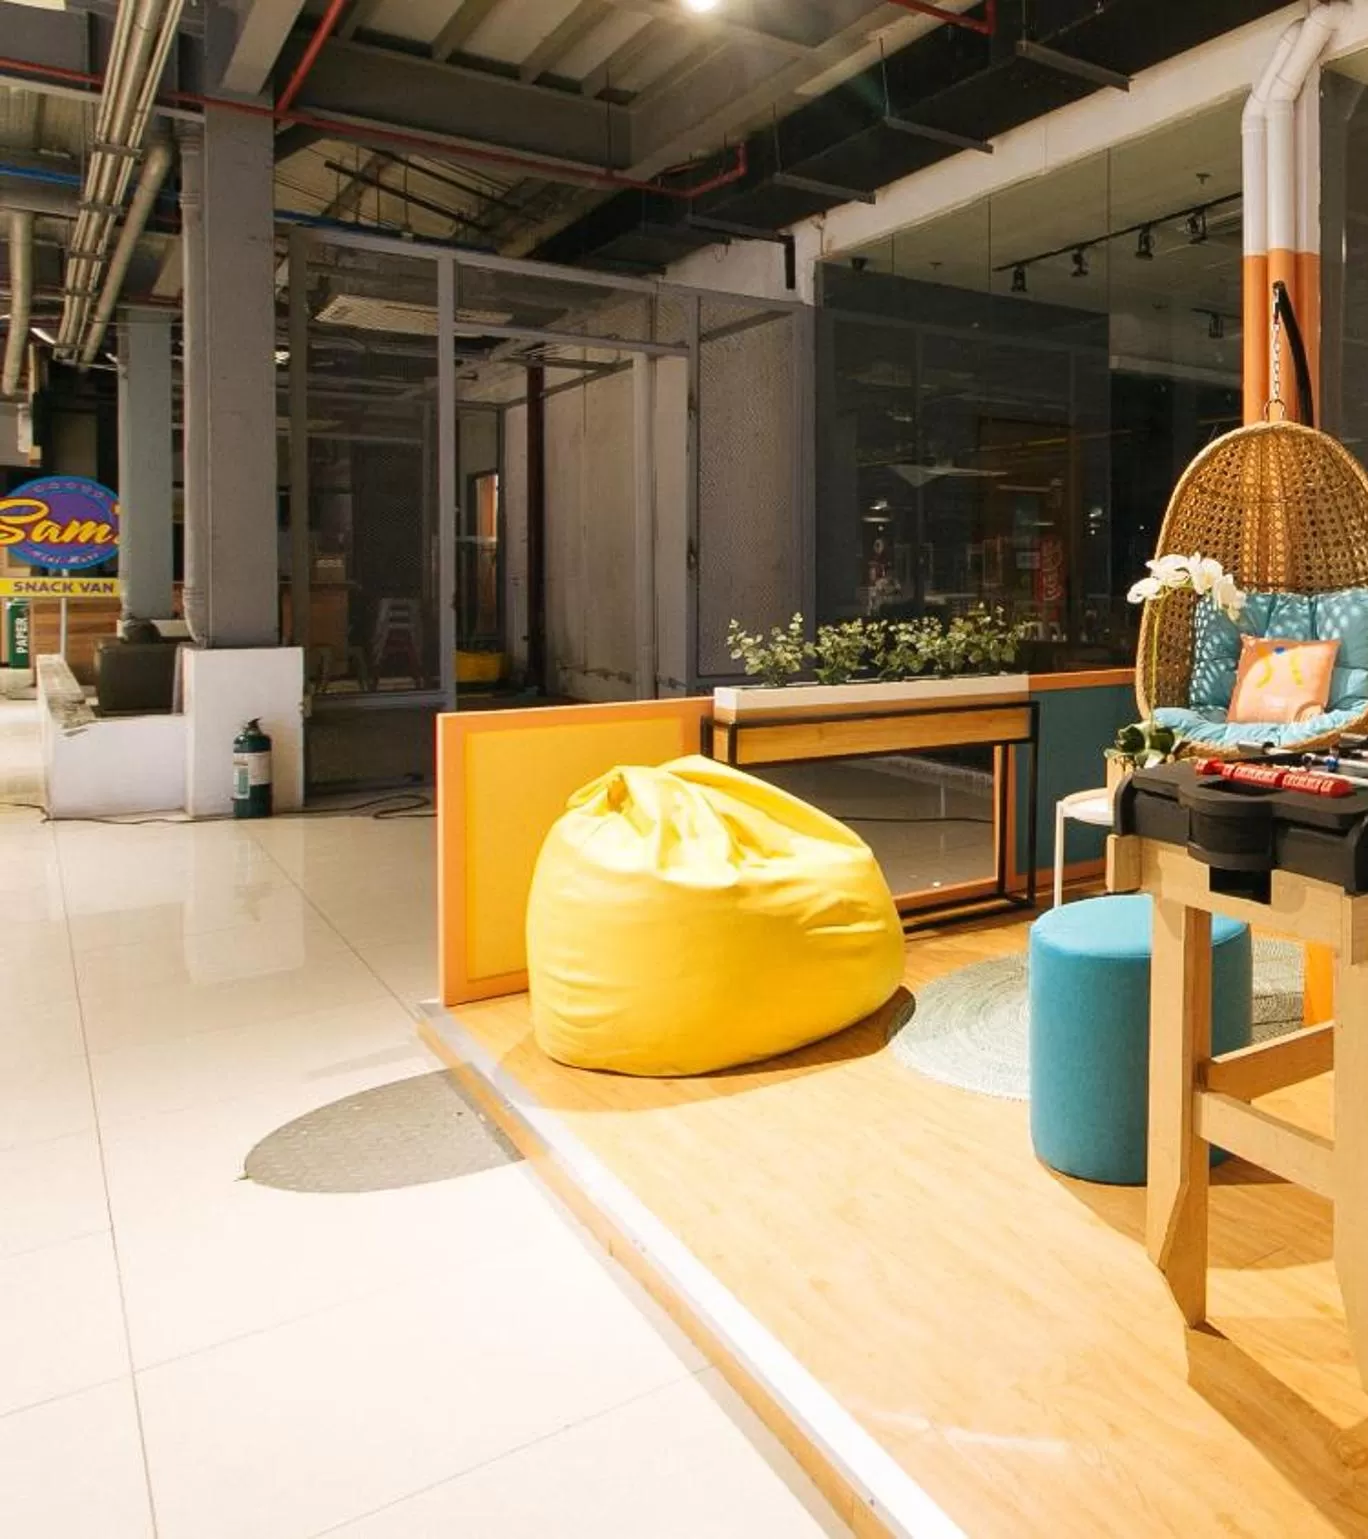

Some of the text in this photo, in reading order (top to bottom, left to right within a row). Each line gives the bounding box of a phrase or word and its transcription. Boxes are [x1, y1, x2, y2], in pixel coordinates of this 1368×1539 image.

[13, 581, 114, 593] SNACK VAN
[15, 617, 28, 654] PAPER
